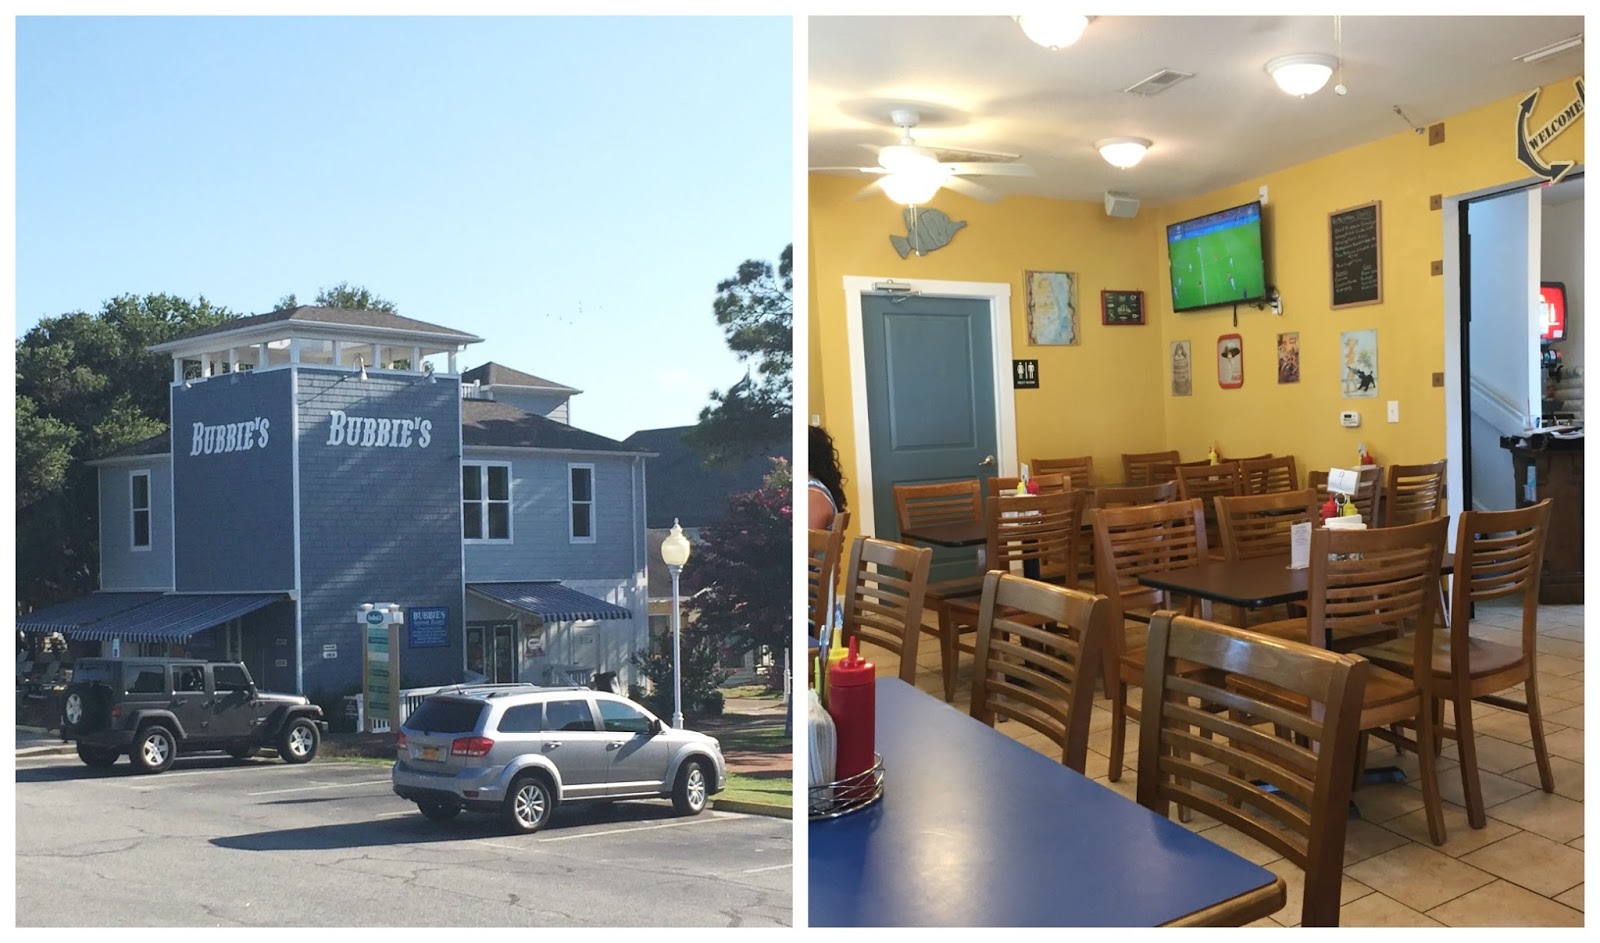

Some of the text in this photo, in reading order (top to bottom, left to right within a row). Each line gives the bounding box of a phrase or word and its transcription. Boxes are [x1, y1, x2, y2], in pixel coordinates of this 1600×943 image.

[1528, 100, 1584, 150] WELCOME
[190, 417, 270, 456] BUBBIE'S
[326, 410, 432, 449] BUBBIE'S
[1338, 471, 1345, 486] 9
